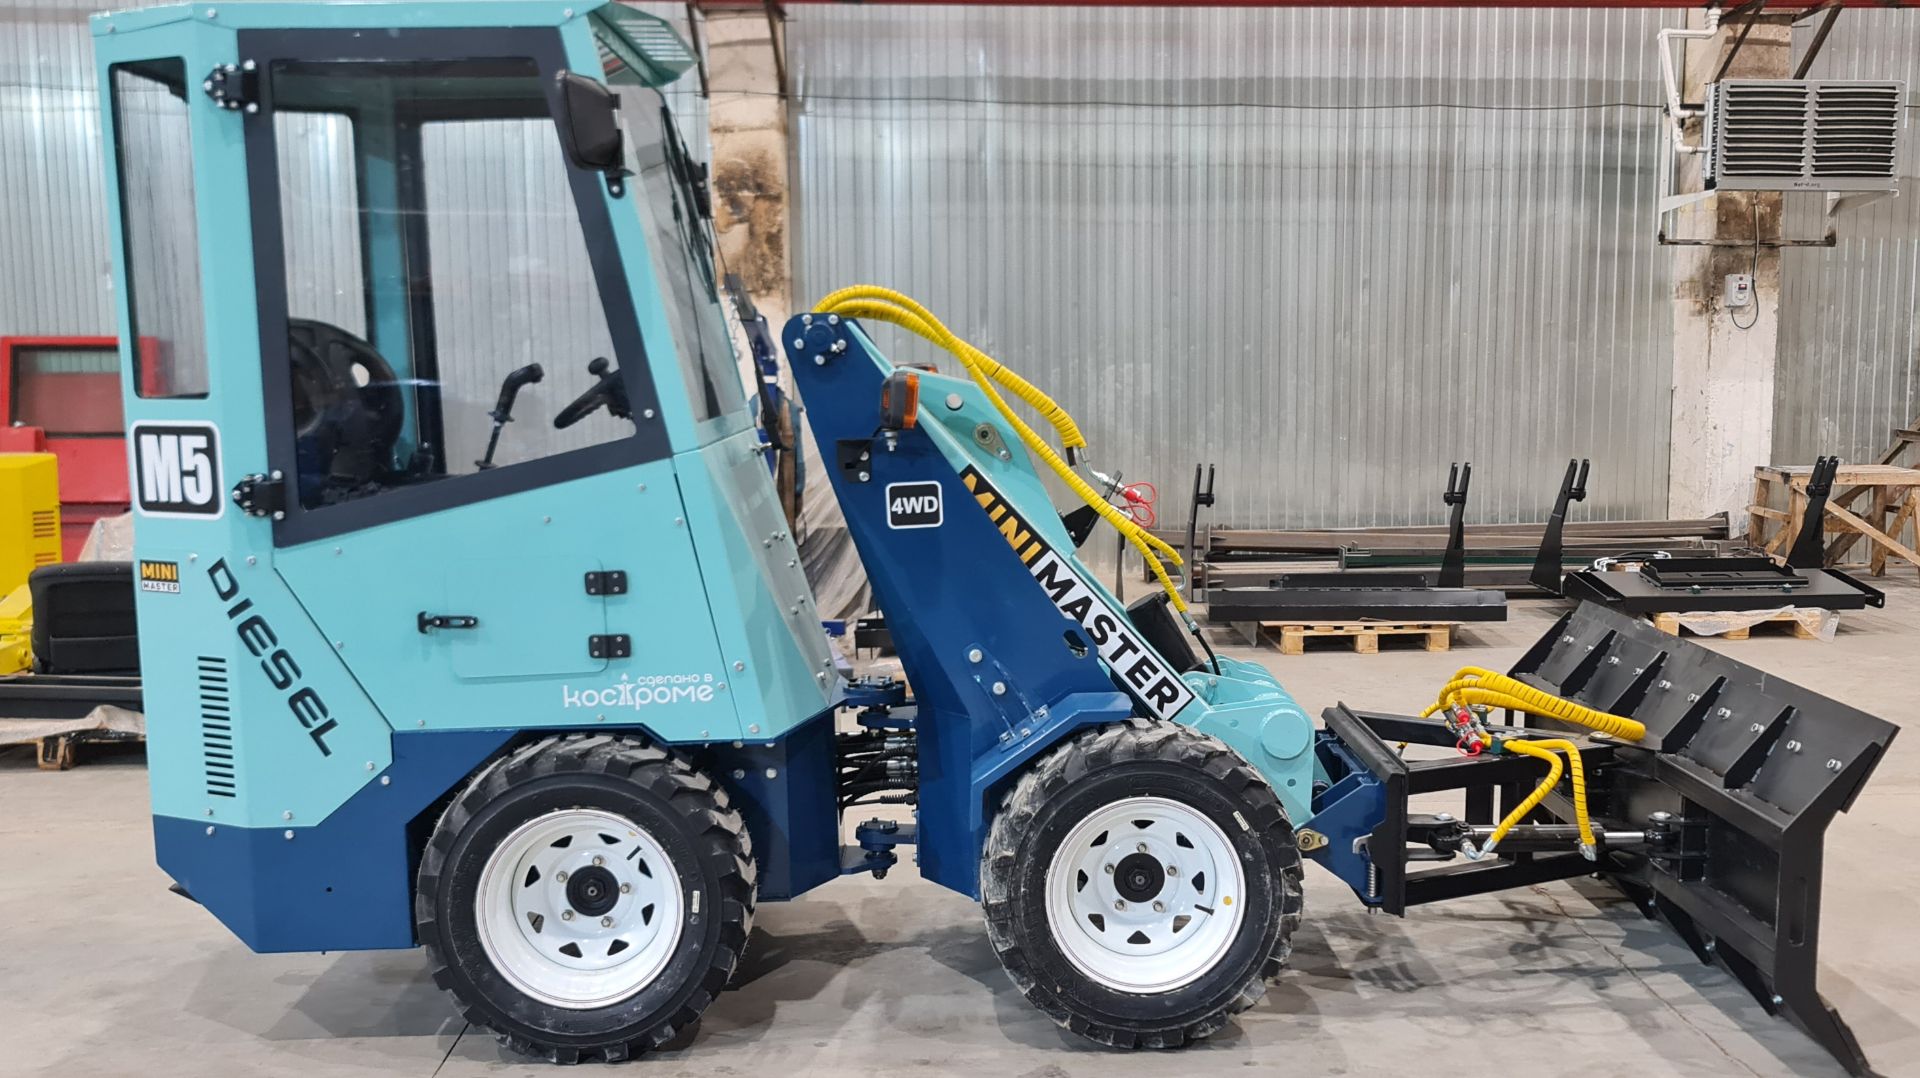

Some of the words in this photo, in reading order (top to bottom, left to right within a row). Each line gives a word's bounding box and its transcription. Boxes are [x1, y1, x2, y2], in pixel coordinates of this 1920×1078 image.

[140, 434, 213, 505] M5
[891, 495, 939, 515] 4WD
[141, 562, 178, 581] MINI
[142, 581, 179, 592] MASTER
[1035, 559, 1180, 714] MASTER
[207, 557, 339, 757] DIESEL
[637, 674, 700, 687] сделано
